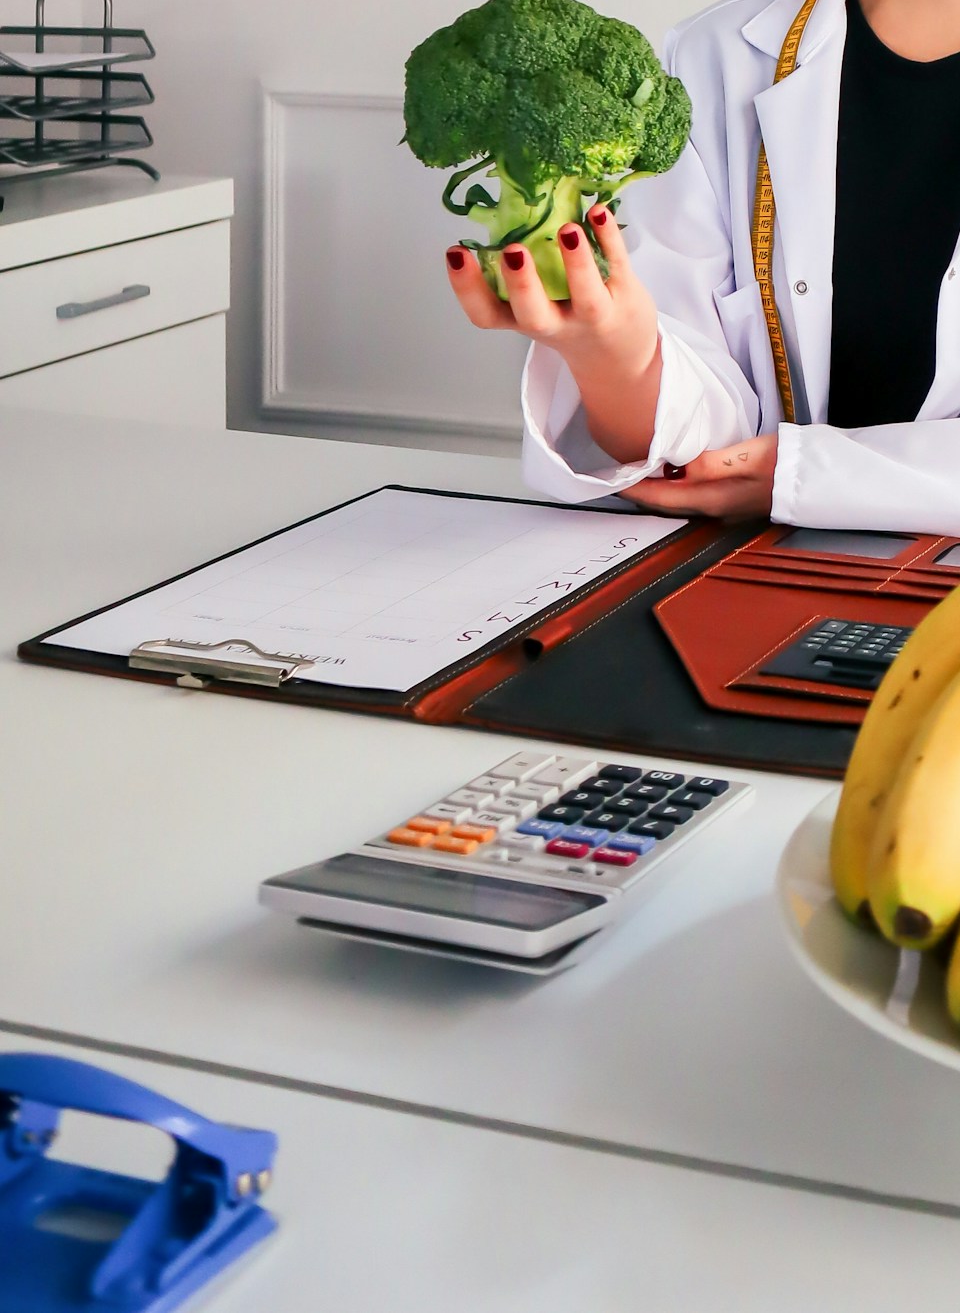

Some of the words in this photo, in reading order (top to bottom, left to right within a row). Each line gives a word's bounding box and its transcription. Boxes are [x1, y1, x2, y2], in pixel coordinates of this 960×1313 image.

[762, 204, 770, 212] 112
[760, 220, 770, 228] 113
[760, 236, 769, 244] 114
[758, 252, 768, 260] 115
[758, 268, 767, 276] 116
[613, 537, 638, 549] S
[590, 552, 620, 563] F
[562, 566, 586, 576] T
[536, 580, 573, 591] W
[515, 596, 539, 606] T
[486, 611, 524, 623] M
[457, 630, 483, 642] S
[650, 771, 675, 782] 00
[593, 779, 610, 788] 3
[700, 778, 714, 786] 0
[638, 785, 654, 794] 2
[574, 793, 589, 802] 6
[683, 792, 692, 800] 1
[616, 798, 634, 807] 5
[552, 807, 568, 816] 9
[662, 806, 678, 815] 4
[477, 814, 504, 823] MU
[597, 814, 614, 822] 8
[642, 821, 660, 829] 7
